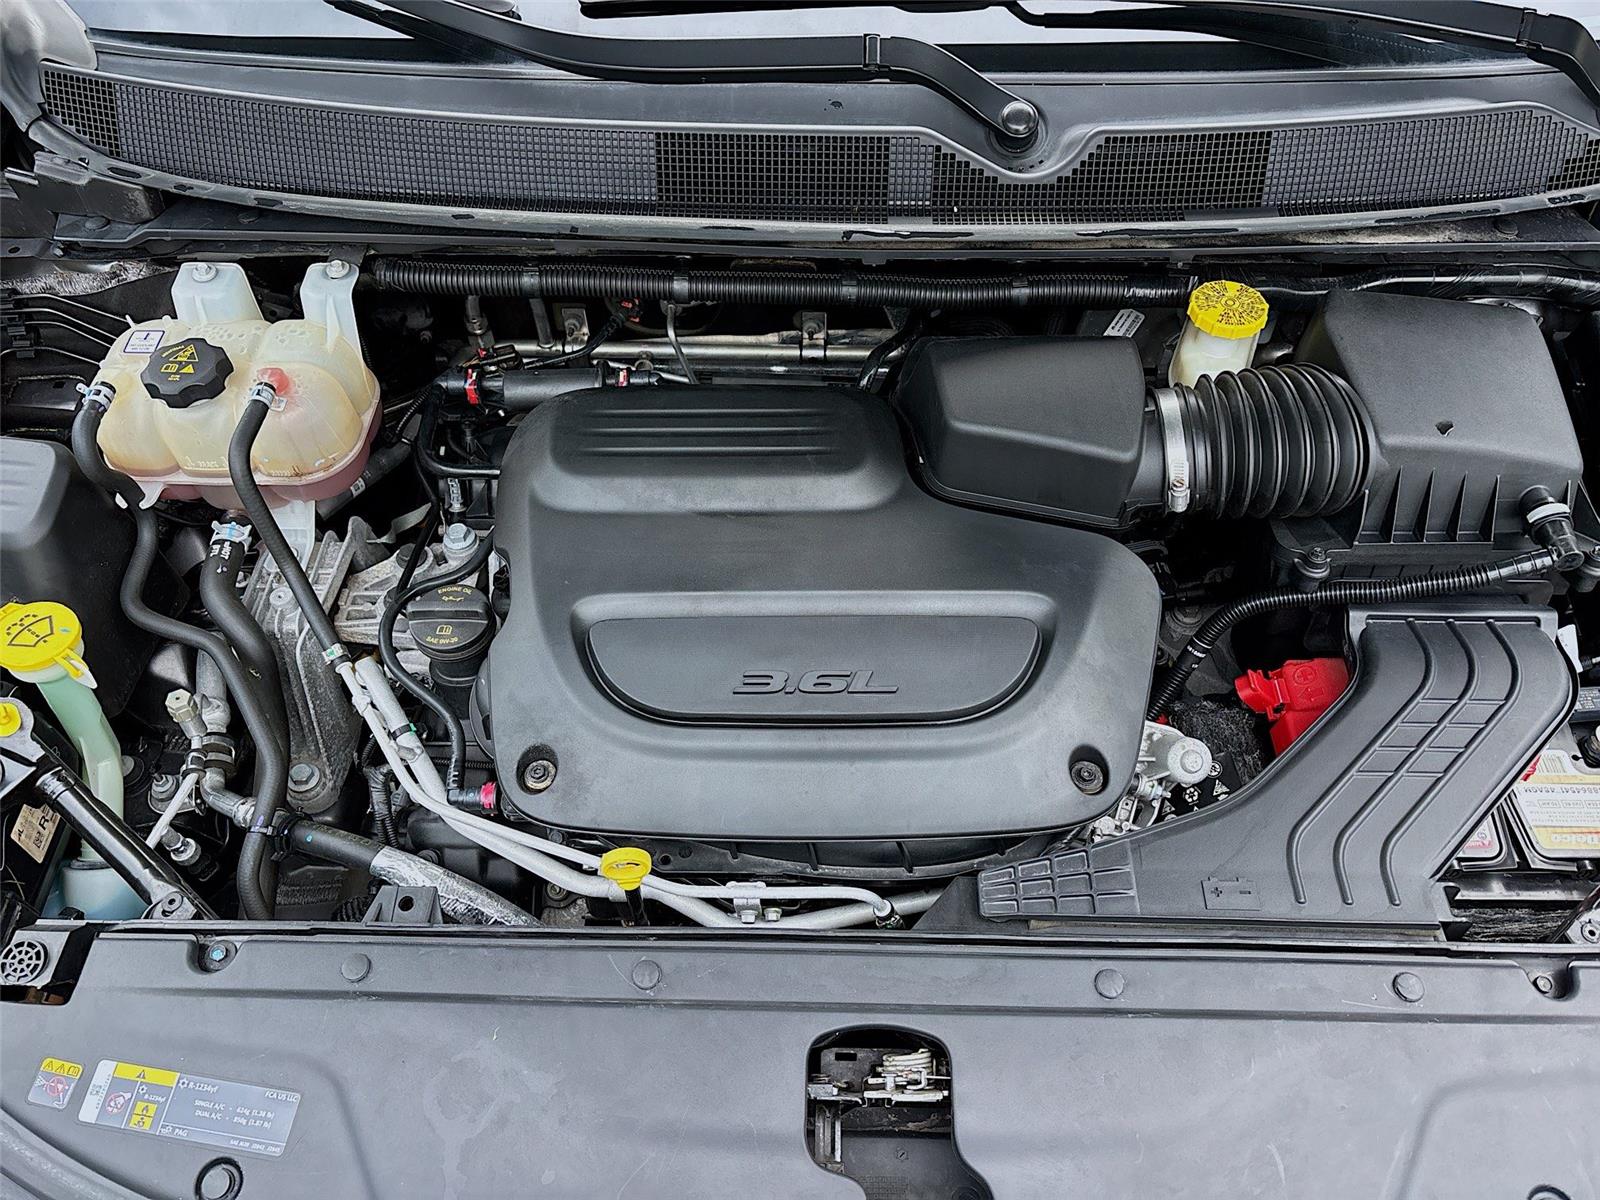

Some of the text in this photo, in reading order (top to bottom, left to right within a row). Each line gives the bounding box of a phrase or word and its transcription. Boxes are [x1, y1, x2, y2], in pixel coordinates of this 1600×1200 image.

[437, 586, 473, 595] ENGINE OIL
[426, 636, 438, 644] SAE
[732, 669, 899, 695] 3.6L
[188, 1081, 219, 1094] R-1234yf
[264, 1089, 298, 1102] FCA US LLC
[214, 1102, 226, 1111] A/C
[211, 1112, 222, 1120] A/C
[173, 1127, 189, 1138] PAG
